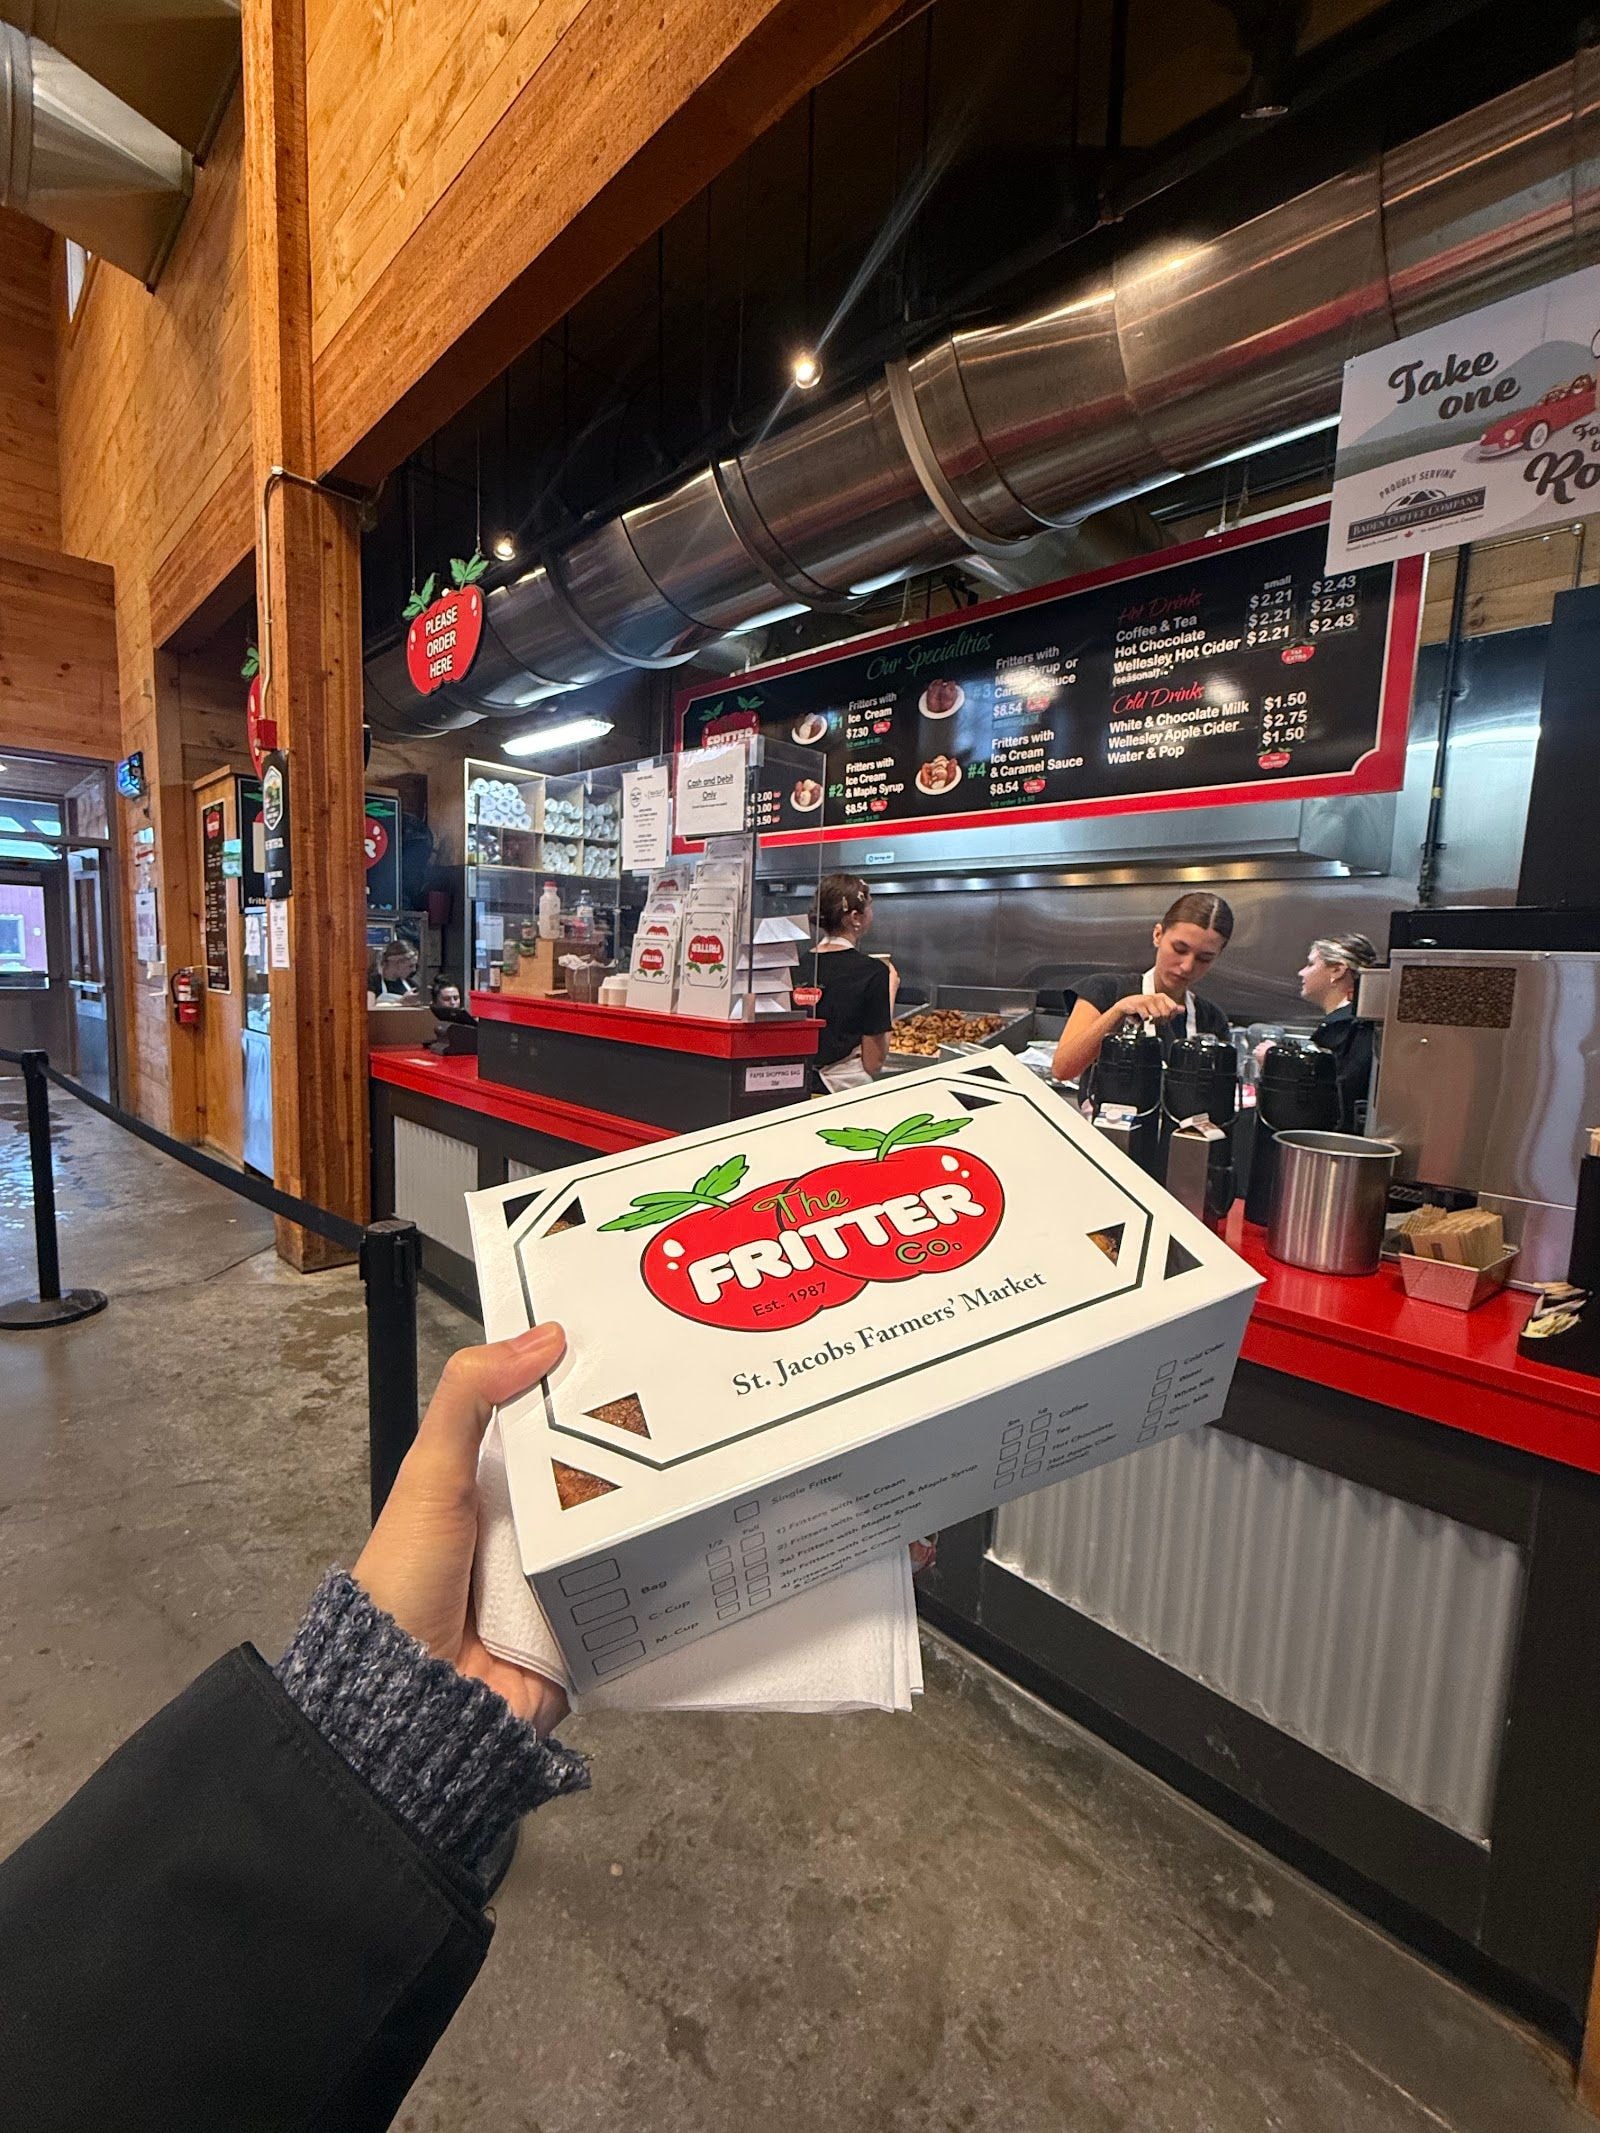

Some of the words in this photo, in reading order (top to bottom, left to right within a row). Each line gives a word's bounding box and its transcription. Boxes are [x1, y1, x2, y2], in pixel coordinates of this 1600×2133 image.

[1388, 351, 1499, 404] Take
[1438, 377, 1522, 419] one
[1572, 421, 1600, 441] Fo
[1379, 474, 1417, 499] PROUDLY
[1419, 469, 1457, 482] SERVING
[1523, 449, 1600, 504] Ro
[1264, 575, 1291, 590] small
[1312, 575, 1356, 596] $2.43
[1116, 625, 1157, 642] Coffee
[1160, 620, 1170, 632] &
[1173, 615, 1198, 629] Tea
[1249, 589, 1292, 610] $2.21
[1311, 594, 1355, 615] $2.43
[425, 605, 458, 637] PLEASE
[1309, 613, 1355, 635] $2.43
[427, 630, 456, 657] ORDER
[1114, 643, 1137, 659] Hot
[1140, 630, 1206, 653] Chocolate
[1248, 608, 1291, 628] $2.21
[996, 653, 1034, 669] Fritters
[1036, 646, 1060, 660] with
[1113, 652, 1173, 674] Wellesley
[1175, 645, 1199, 662] Hot
[1202, 638, 1241, 656] Cider
[1246, 625, 1290, 647] $2.21
[429, 655, 453, 678] HERE
[1028, 662, 1060, 676] Syrup
[1065, 658, 1079, 670] or
[1040, 673, 1076, 688] Sauce
[849, 697, 878, 711] Fritters
[879, 692, 897, 705] with
[1113, 690, 1149, 714] Cold
[1151, 681, 1204, 708] Drinks
[829, 716, 843, 731] #1
[848, 713, 861, 724] Ice
[864, 707, 892, 720] Cream
[993, 702, 1023, 718] $8.54
[1109, 718, 1142, 734] White
[1144, 716, 1154, 728] &
[1156, 706, 1220, 725] Chocolate
[1222, 700, 1249, 716] Milk
[1264, 691, 1306, 712] $1.50
[992, 735, 1029, 749] Fritters
[1031, 729, 1054, 743] with
[1108, 732, 1163, 750] Wellesley
[1164, 726, 1200, 743] Apple
[1202, 720, 1240, 736] Cider
[1263, 710, 1308, 730] $2.75
[991, 752, 1006, 764] Ice
[1008, 748, 1044, 761] Cream
[1107, 750, 1144, 765] Water
[1146, 747, 1157, 760] &
[1159, 744, 1185, 759] Pop
[1262, 727, 1304, 746] $1.50
[846, 762, 875, 774] Fritters
[876, 757, 894, 768] with
[967, 762, 986, 779] #4
[990, 767, 999, 778] &
[1000, 760, 1044, 777] Caramel
[1047, 757, 1083, 770] Sauce
[688, 779, 702, 788] Cash
[704, 777, 715, 786] and
[717, 774, 734, 784] Debit
[829, 783, 844, 798] #2
[845, 788, 852, 798] &
[853, 786, 877, 797] Maple
[879, 782, 904, 795] Syrup
[845, 775, 858, 786] Ice
[860, 772, 887, 783] Cream
[990, 781, 1019, 796] $8.54
[703, 791, 717, 800] Only
[845, 801, 868, 815] $8.54
[752, 1188, 849, 1223] The
[687, 1182, 986, 1304] FRITTER
[752, 1302, 786, 1317] Est.
[788, 1282, 828, 1304] 1987
[732, 1373, 771, 1396] St.
[774, 1341, 856, 1387] Jacobs
[958, 1271, 1048, 1312] Market
[1059, 1402, 1089, 1418] Coffee
[771, 1487, 806, 1504] Single
[808, 1472, 843, 1489] Fritter
[788, 1510, 828, 1530] Fritters
[830, 1500, 853, 1512] with
[856, 1493, 870, 1502] Ice
[873, 1478, 906, 1495] Cream
[790, 1526, 828, 1546] Fritters
[830, 1516, 853, 1528] with
[872, 1495, 905, 1511] Cream
[918, 1476, 948, 1491] Maple
[951, 1465, 978, 1479] Syrup
[797, 1539, 834, 1556] Fritters
[861, 1514, 892, 1530] Maple
[894, 1502, 922, 1516] Syrup
[641, 1580, 667, 1594] Bag
[648, 1600, 691, 1620] C-Cup
[656, 1622, 699, 1643] M-Cup
